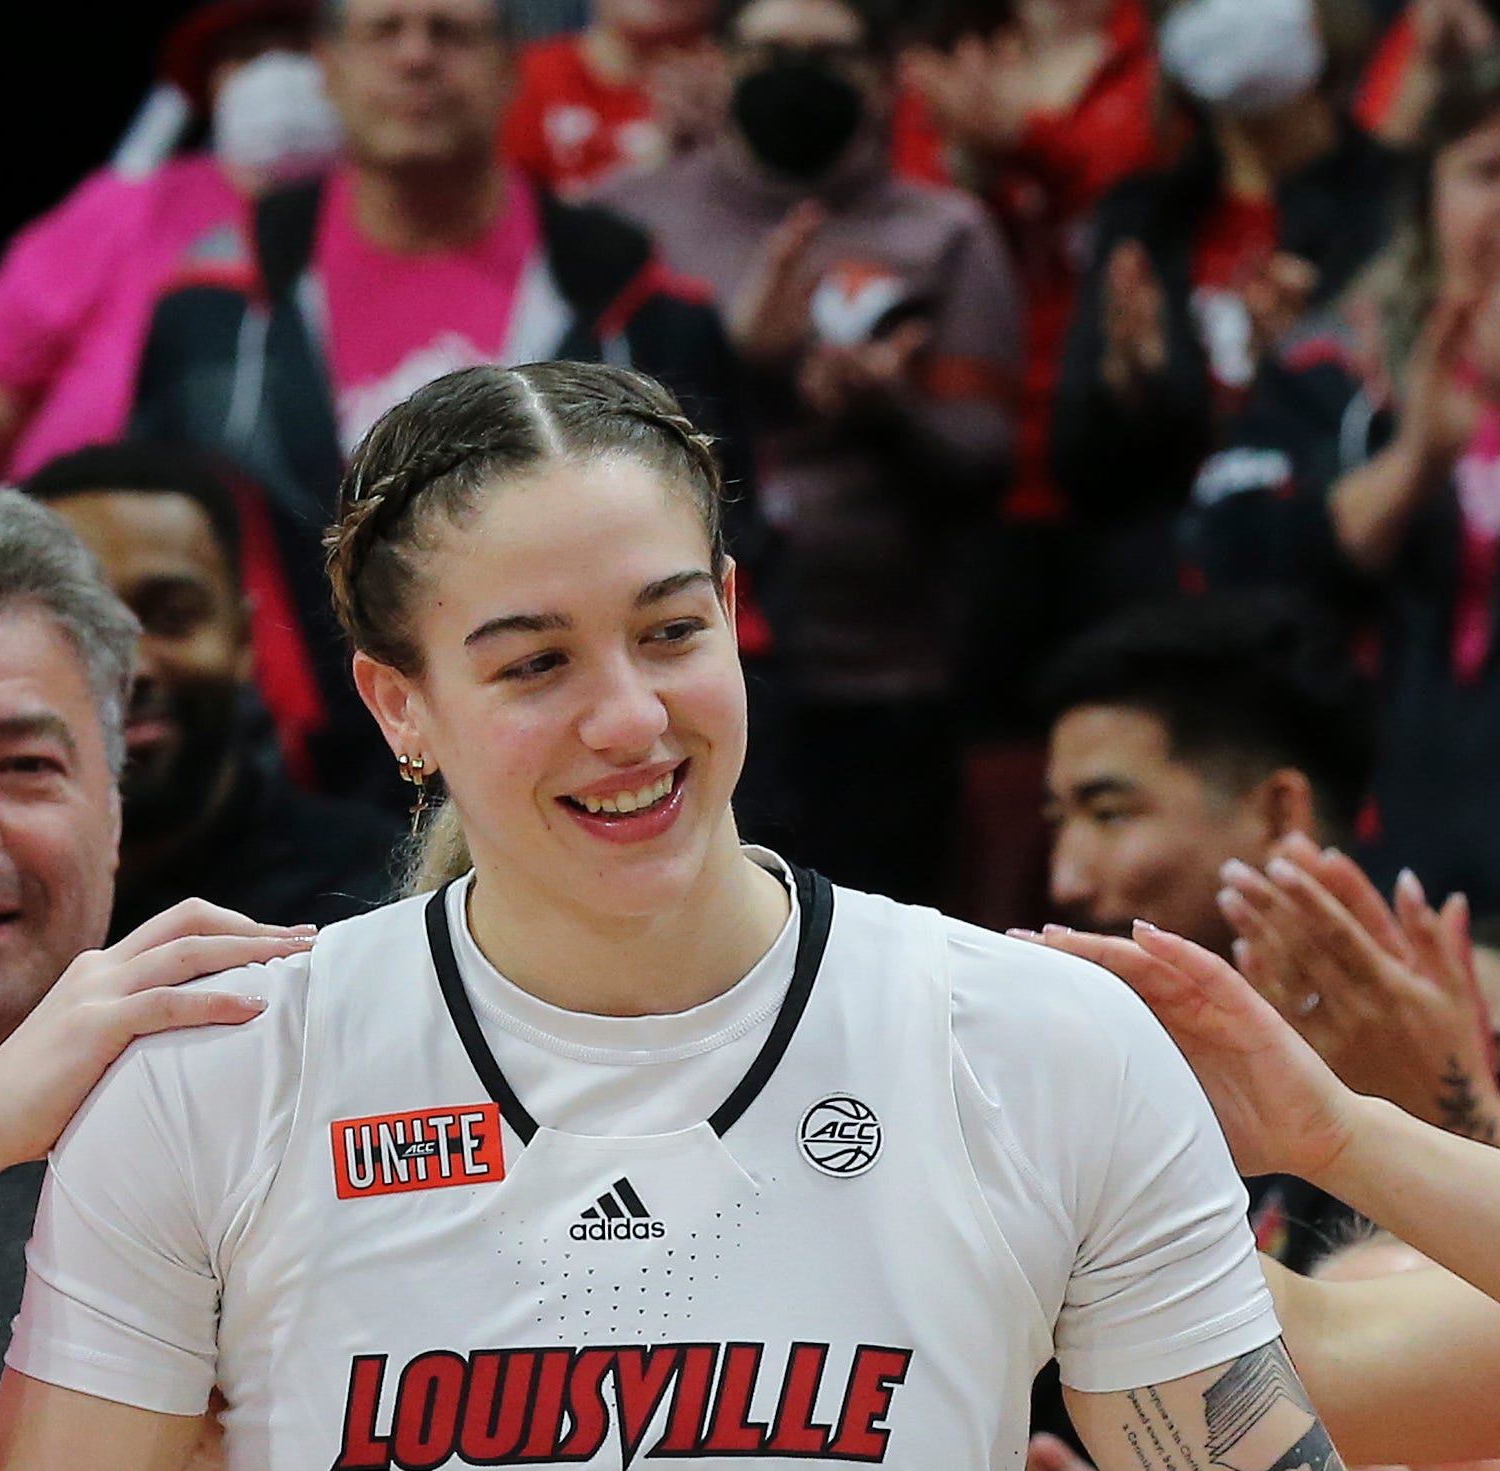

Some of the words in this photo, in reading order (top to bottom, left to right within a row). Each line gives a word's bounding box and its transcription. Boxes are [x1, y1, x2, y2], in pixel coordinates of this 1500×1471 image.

[809, 1120, 878, 1141] ACC
[343, 1112, 490, 1190] UNITE
[404, 1141, 436, 1156] ACC
[569, 1217, 665, 1241] adidas
